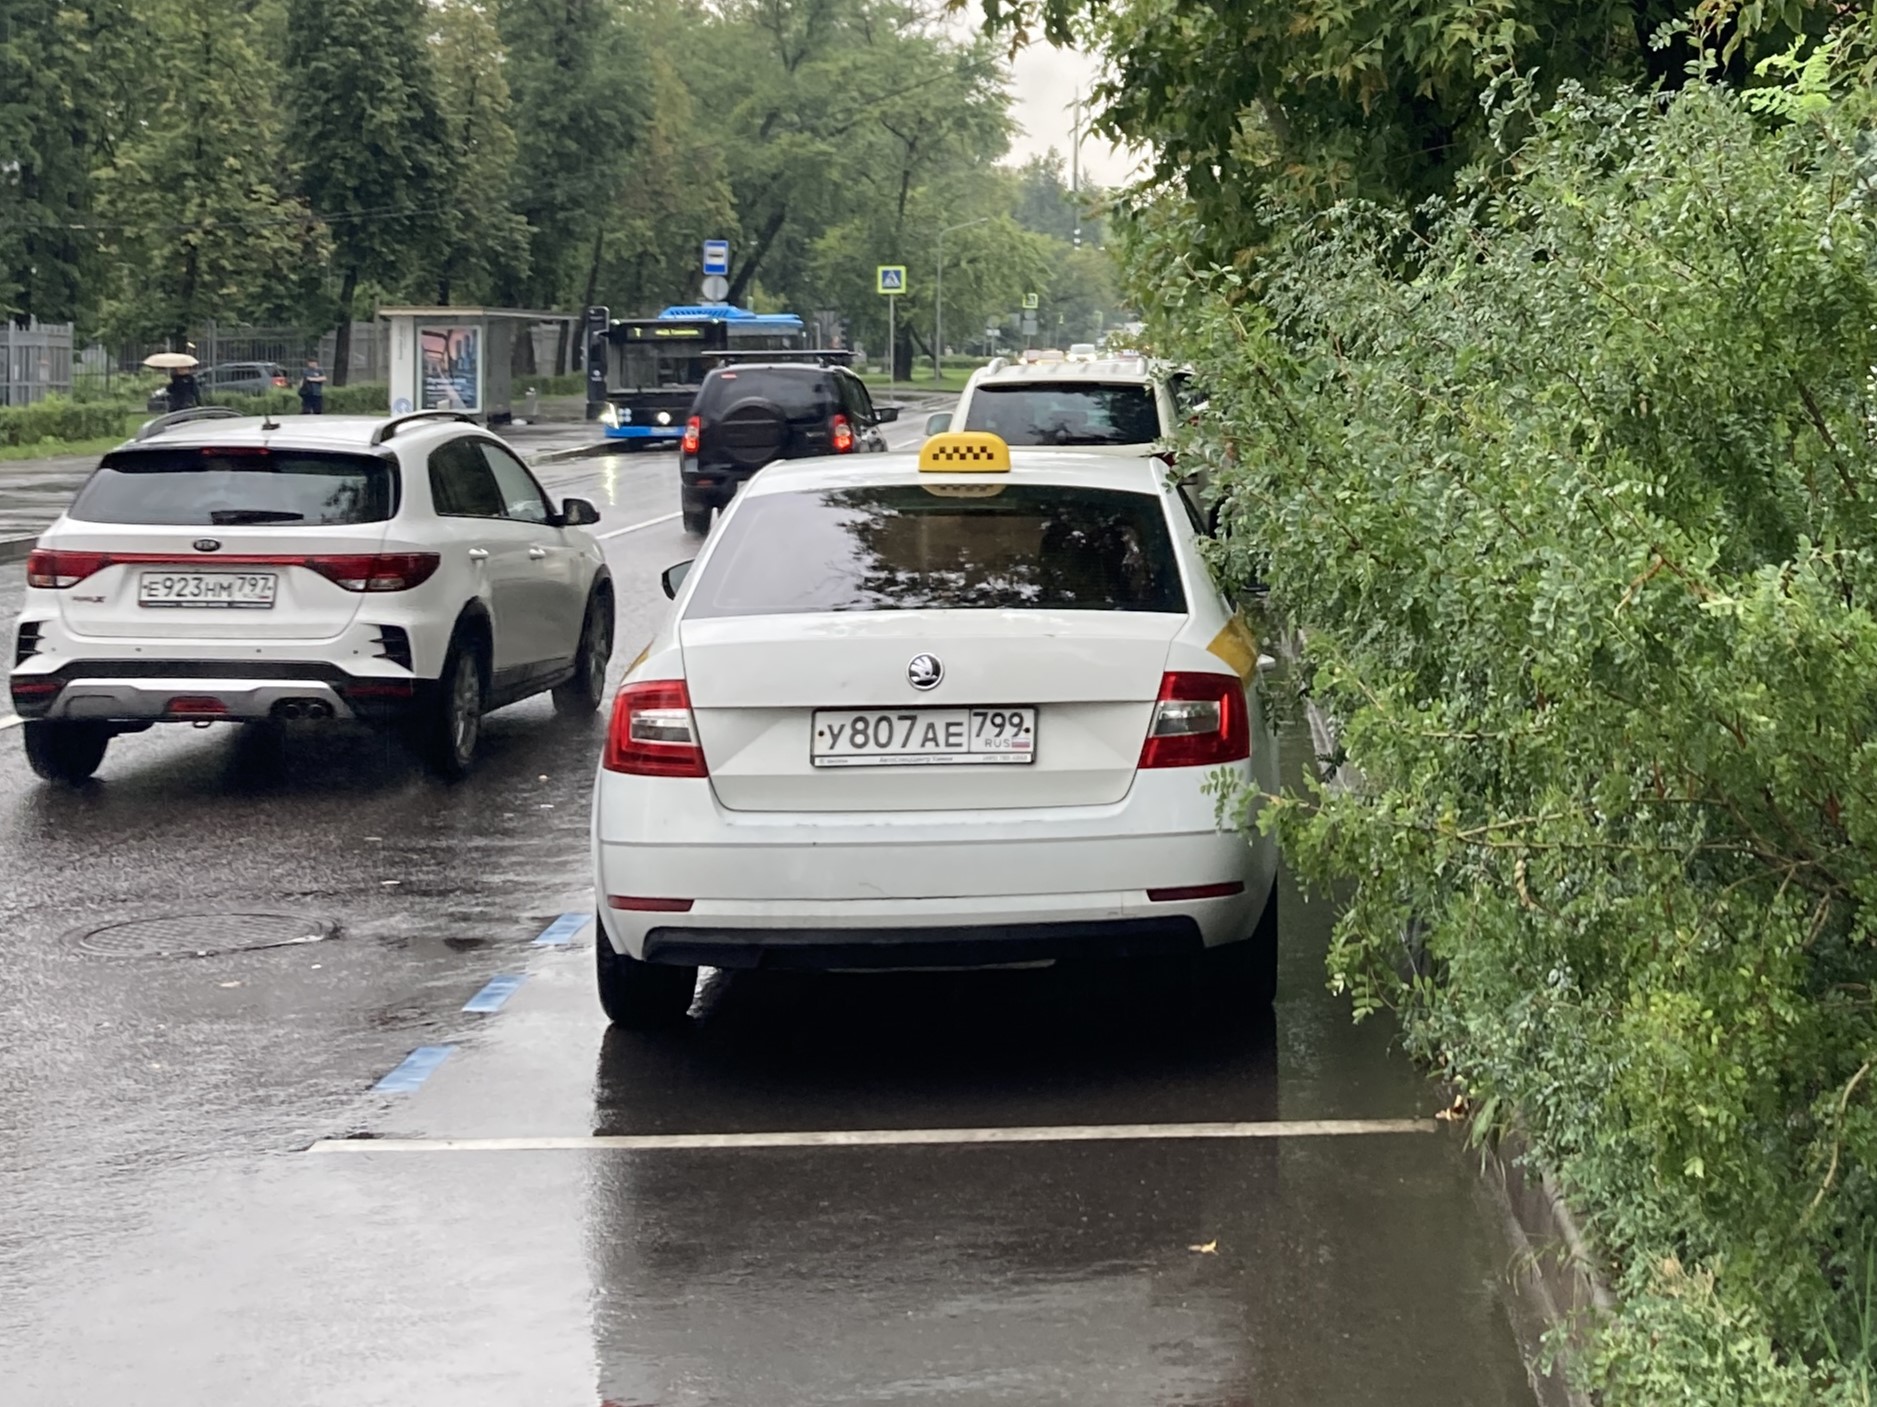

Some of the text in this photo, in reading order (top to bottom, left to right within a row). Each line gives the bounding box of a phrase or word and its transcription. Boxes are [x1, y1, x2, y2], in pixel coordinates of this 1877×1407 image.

[148, 577, 269, 597] Е923НМ 797
[827, 711, 1024, 750] У807АЕ 799
[984, 738, 1010, 748] RUS
